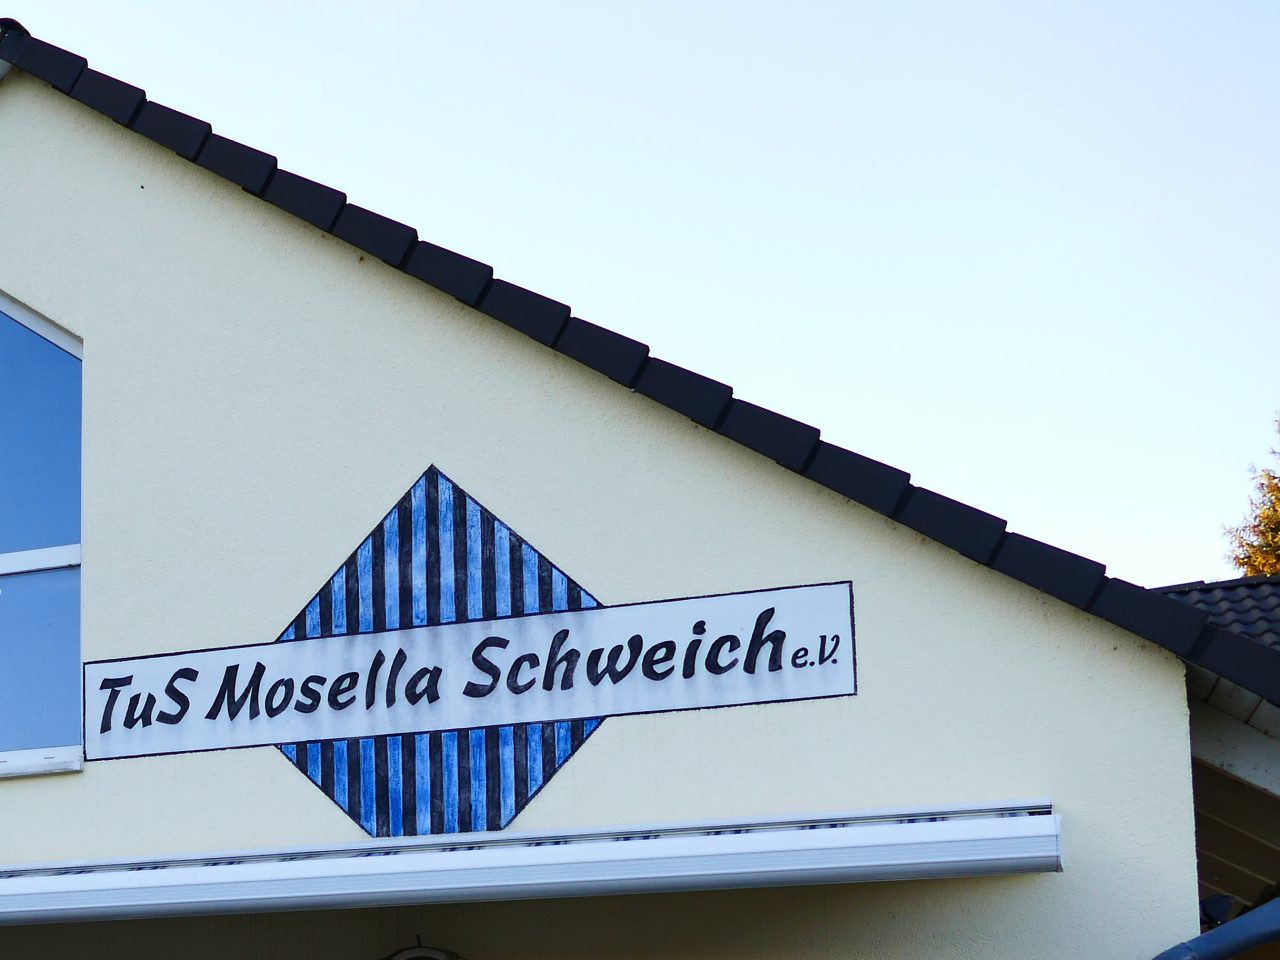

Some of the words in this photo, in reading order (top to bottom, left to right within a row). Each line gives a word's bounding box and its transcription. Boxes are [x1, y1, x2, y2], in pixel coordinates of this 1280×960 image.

[99, 668, 199, 734] TuS
[205, 648, 442, 721] Mosella
[462, 607, 786, 698] Schweich
[791, 634, 840, 668] e.V.
